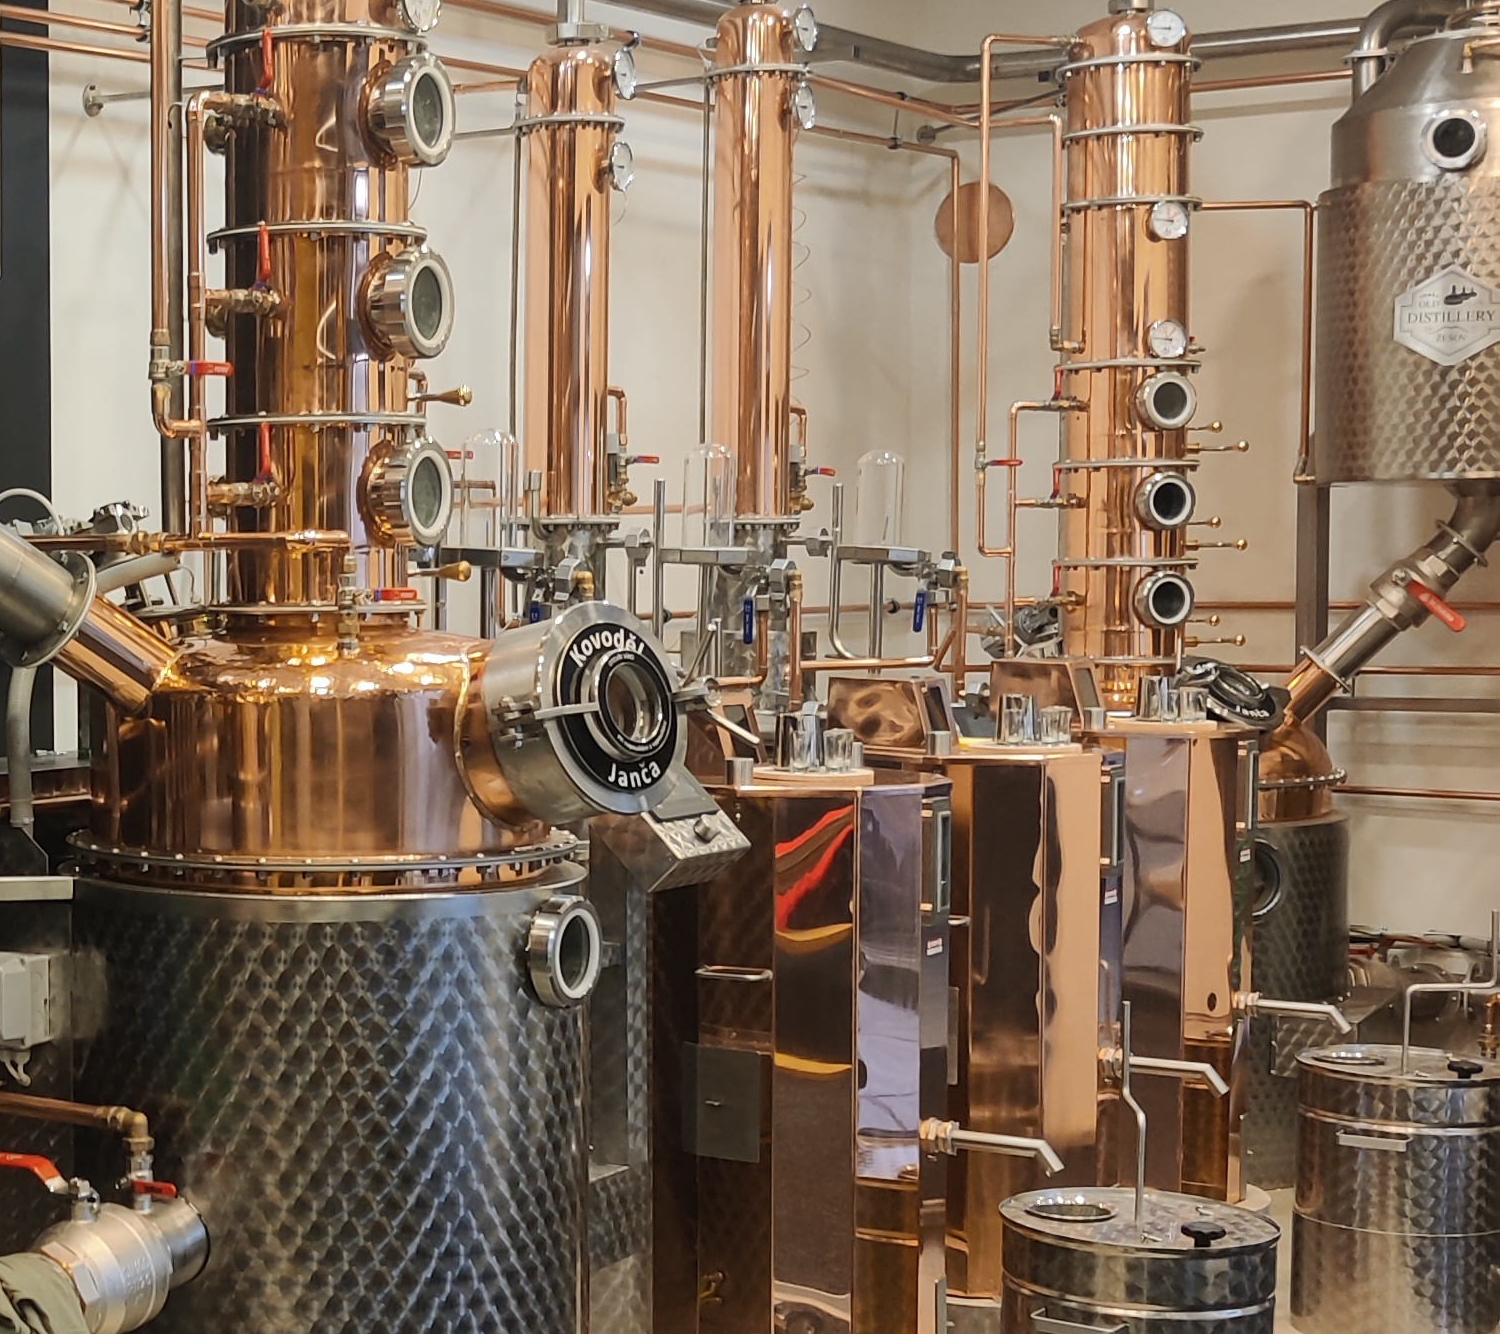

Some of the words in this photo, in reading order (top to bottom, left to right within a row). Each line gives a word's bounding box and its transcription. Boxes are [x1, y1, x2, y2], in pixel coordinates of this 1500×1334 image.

[1407, 310, 1497, 325] DISTILLERY
[569, 628, 645, 668] Kovoděl
[607, 761, 661, 788] Janča
